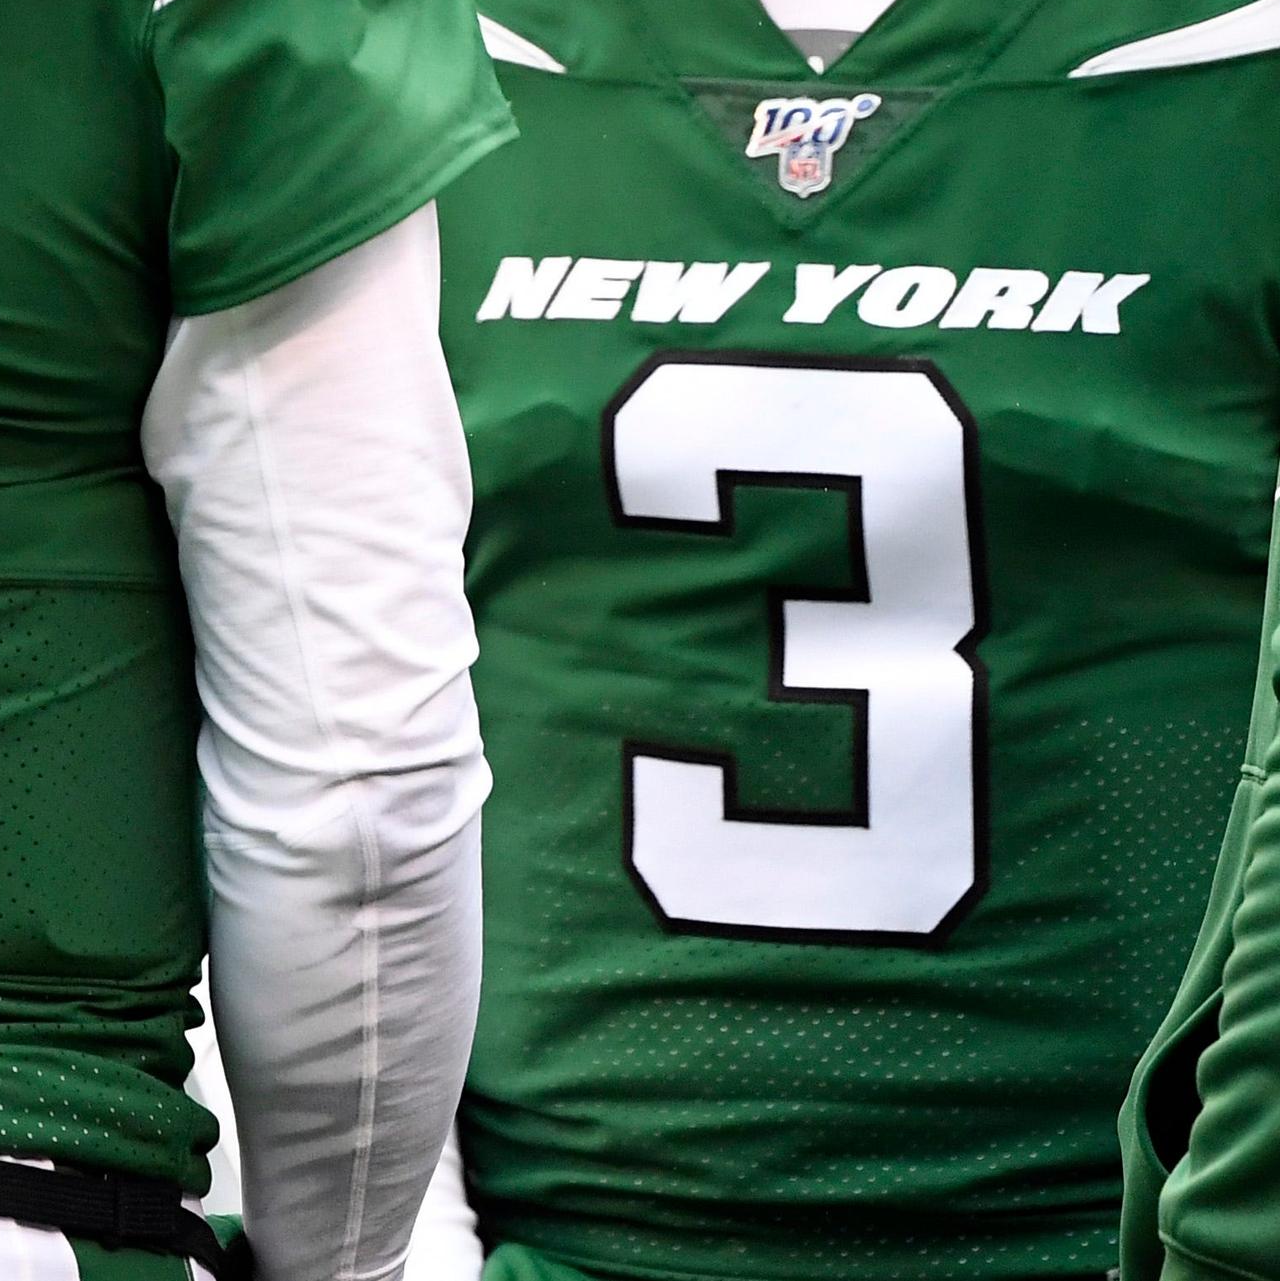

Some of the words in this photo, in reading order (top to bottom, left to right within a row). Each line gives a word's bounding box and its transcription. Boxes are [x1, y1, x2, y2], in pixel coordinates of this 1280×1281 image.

[477, 256, 771, 322] NEW
[782, 263, 1151, 334] YORK
[602, 350, 990, 948] 3
